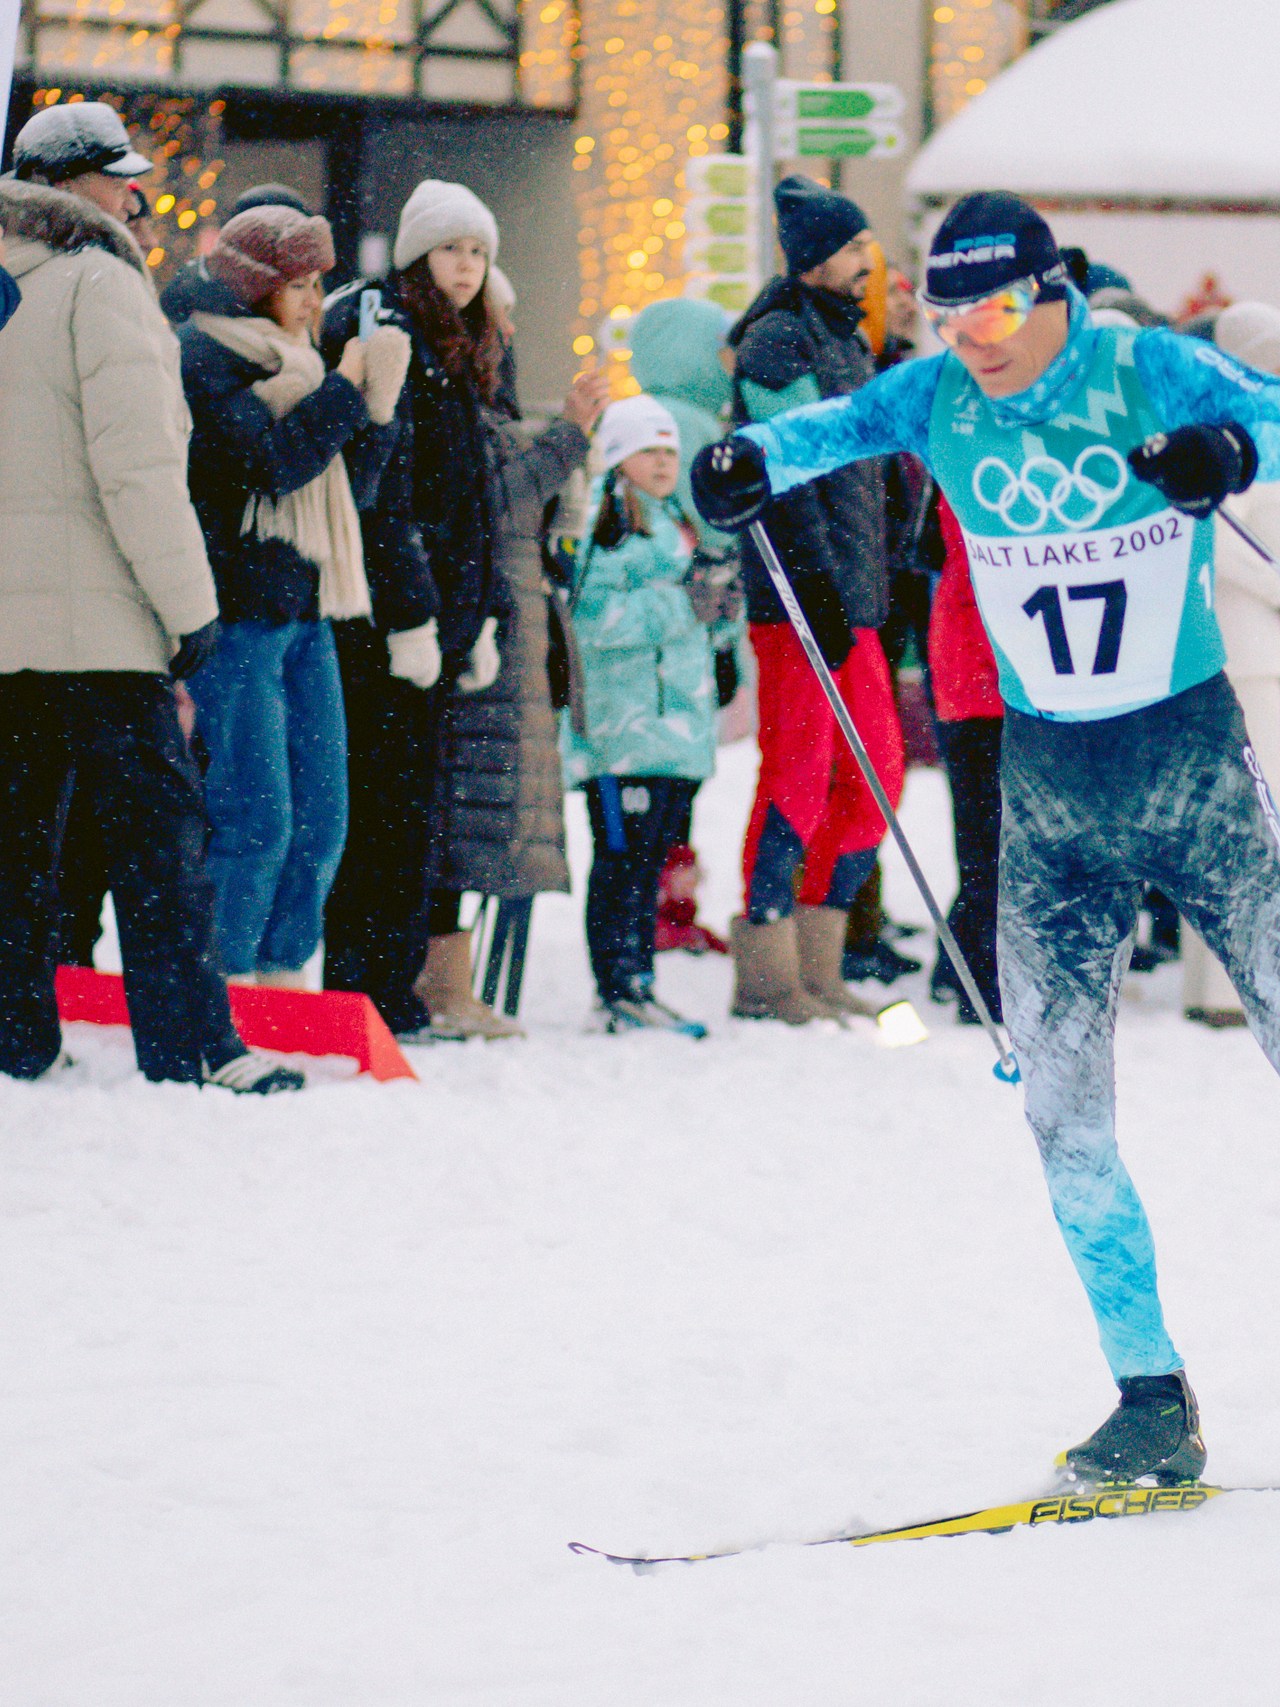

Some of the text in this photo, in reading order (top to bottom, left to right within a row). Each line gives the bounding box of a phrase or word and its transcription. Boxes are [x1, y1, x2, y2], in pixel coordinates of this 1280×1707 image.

[1023, 541, 1101, 567] LAKE
[1109, 516, 1183, 559] 2002
[1020, 577, 1128, 676] 17
[1029, 1490, 1208, 1527] FISCHER
